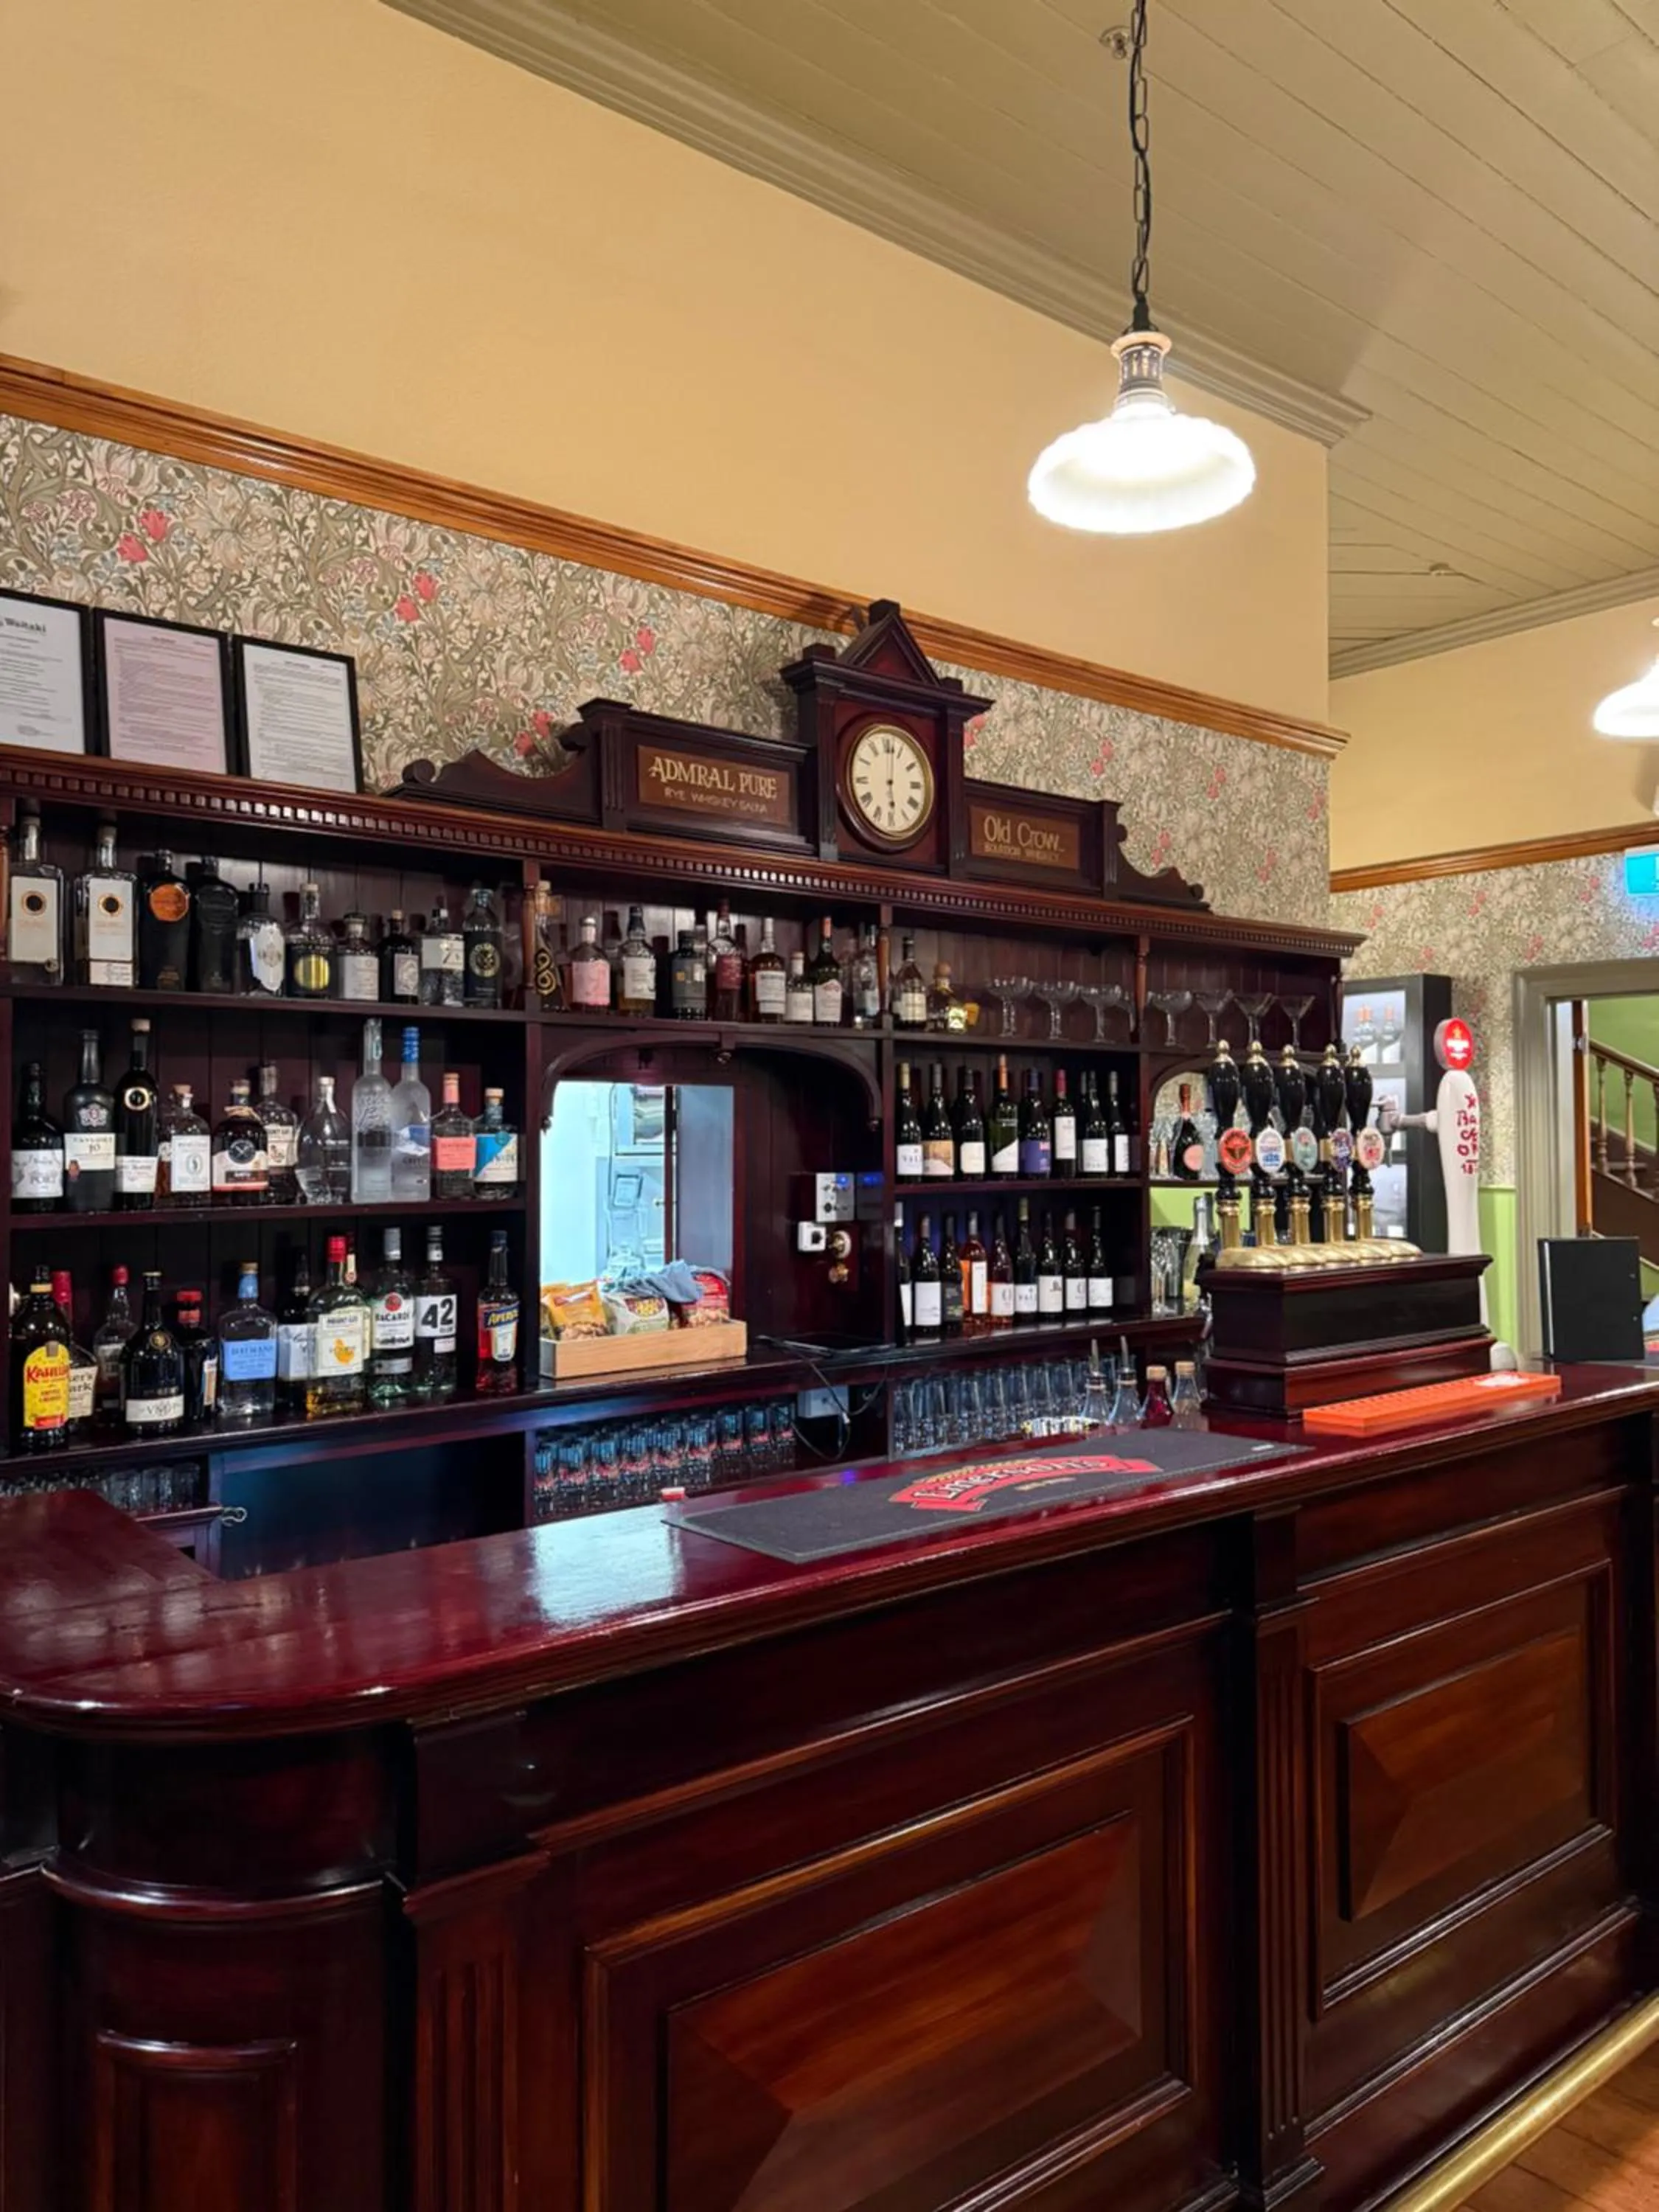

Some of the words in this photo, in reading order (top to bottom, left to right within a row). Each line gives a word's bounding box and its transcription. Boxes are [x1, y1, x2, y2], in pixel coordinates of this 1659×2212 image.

[739, 773, 777, 799] PURE
[984, 815, 1011, 844] Old
[421, 1297, 453, 1329] 42
